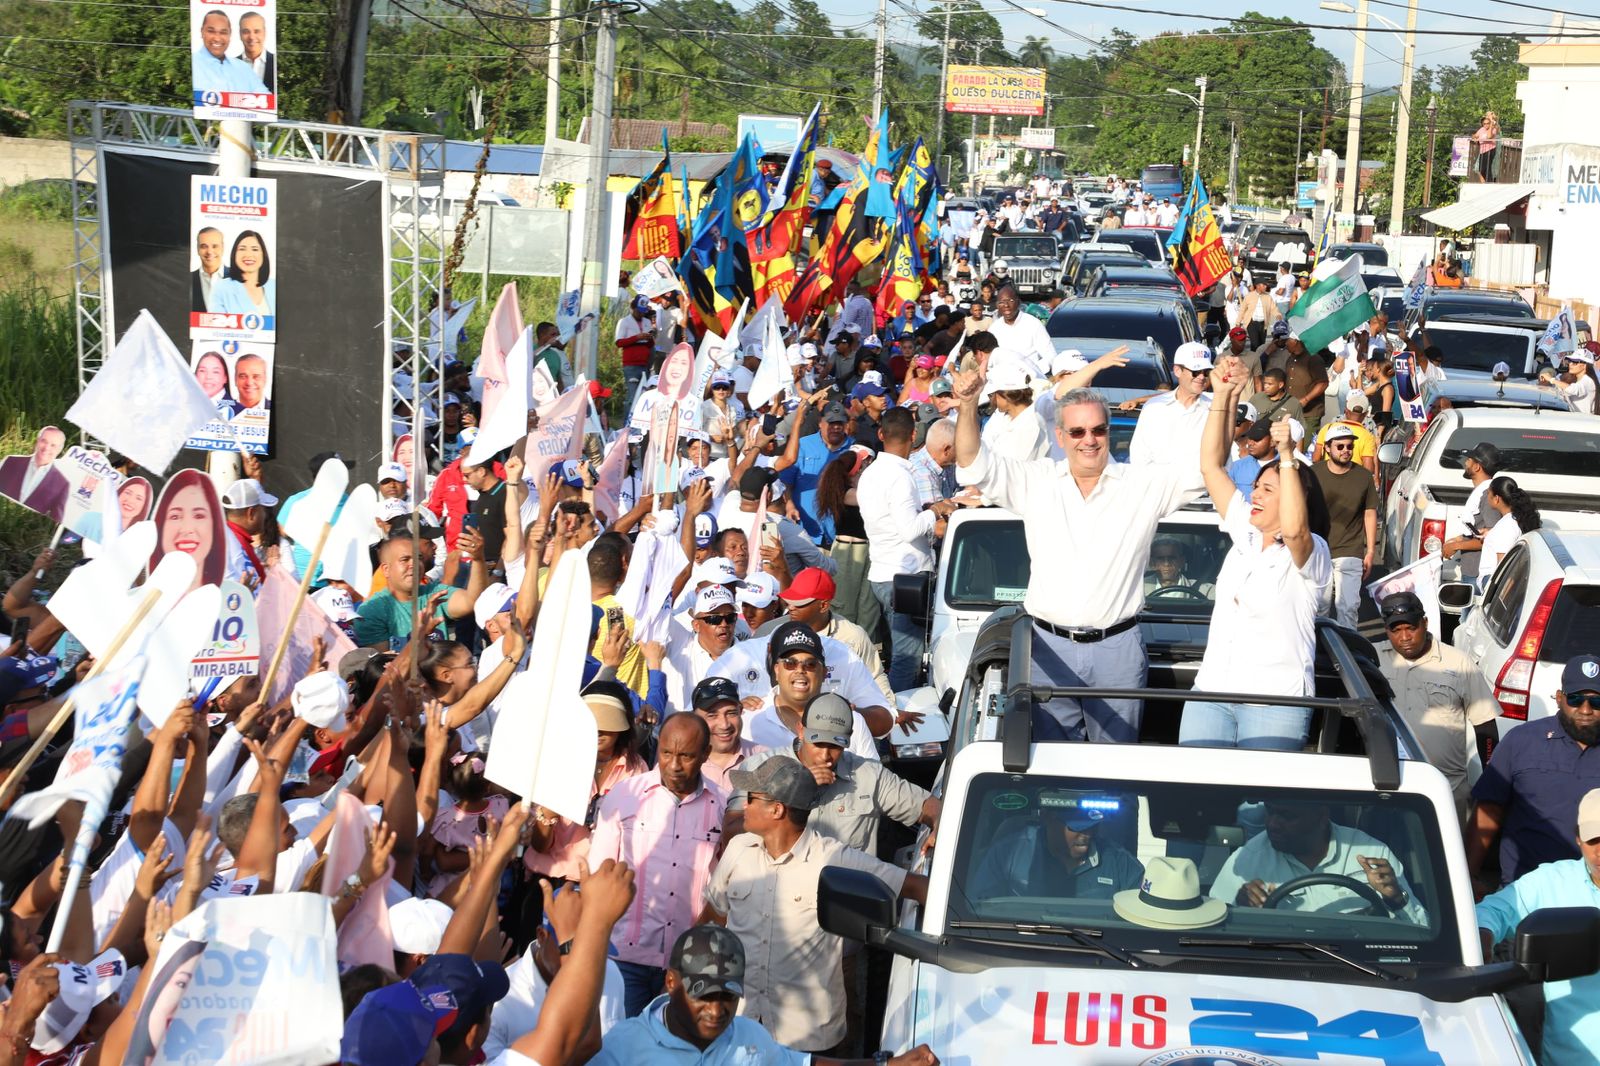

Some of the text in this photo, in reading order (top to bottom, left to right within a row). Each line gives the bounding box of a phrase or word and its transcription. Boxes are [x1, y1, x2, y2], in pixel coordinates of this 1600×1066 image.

[953, 74, 986, 86] PARADA
[988, 77, 998, 86] LA
[1026, 78, 1042, 88] DEL
[952, 87, 987, 98] QUESO
[1567, 165, 1600, 184] ME
[200, 183, 268, 206] MECHO
[206, 205, 262, 216] SENADORA
[1203, 245, 1232, 279] LUIS
[1410, 404, 1425, 419] 24
[241, 426, 267, 437] JESUS
[187, 438, 266, 453] DIPUTADA
[69, 447, 120, 481] Mecho
[193, 661, 253, 677] MIRABAL
[1032, 991, 1447, 1066] LUIS 24
